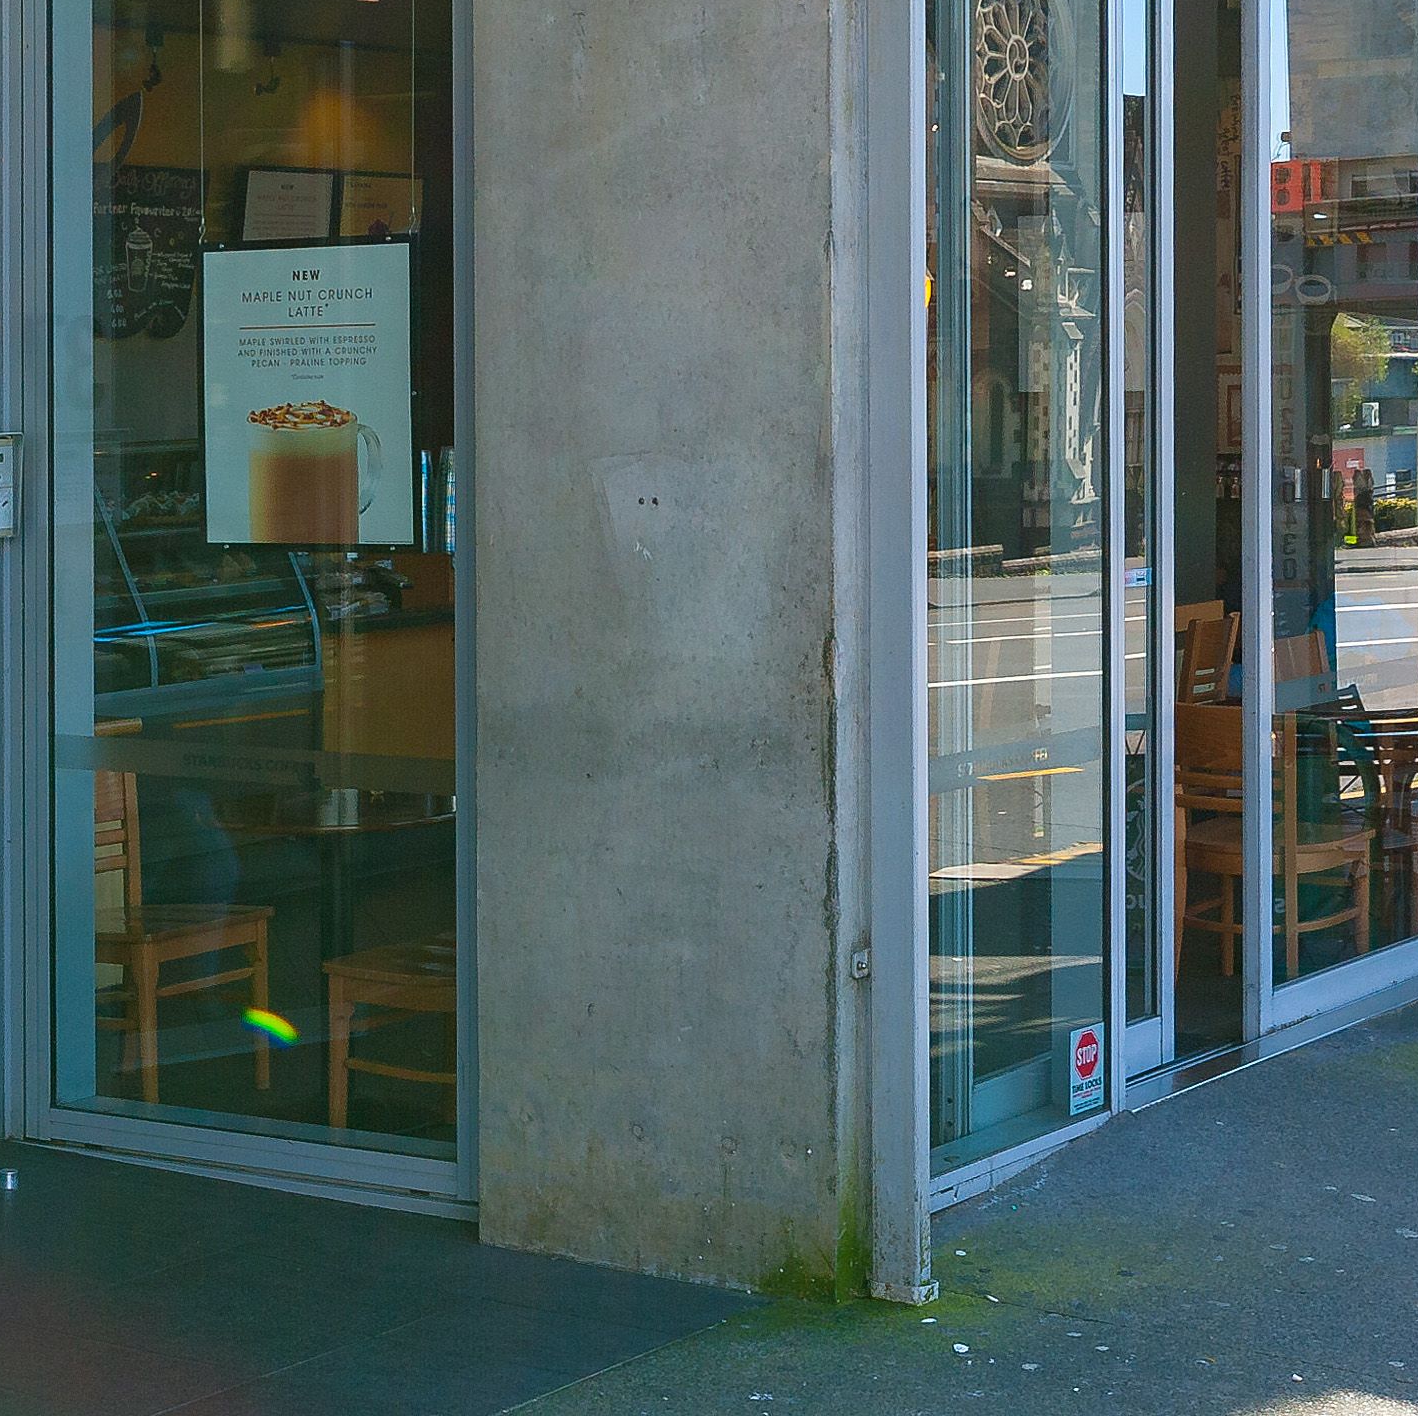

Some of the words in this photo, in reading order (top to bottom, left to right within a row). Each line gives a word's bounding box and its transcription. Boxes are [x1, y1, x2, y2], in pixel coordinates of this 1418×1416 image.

[292, 269, 321, 282] NEW
[241, 290, 282, 304] MAPLE
[288, 289, 312, 302] NUT
[317, 287, 373, 301] CRUNCH
[238, 337, 266, 347] MAPLE
[269, 336, 305, 346] SWIRLED
[309, 335, 329, 345] WITH
[333, 334, 376, 345] ESPRESSO
[237, 349, 257, 358] AND
[259, 348, 298, 357] FINISHED
[301, 347, 321, 356] WITH
[334, 346, 378, 355] CRUNCHY
[251, 359, 280, 368] PECAN
[289, 358, 325, 367] PRALINE
[328, 357, 367, 366] TOPPING
[1076, 1044, 1097, 1067] STOP
